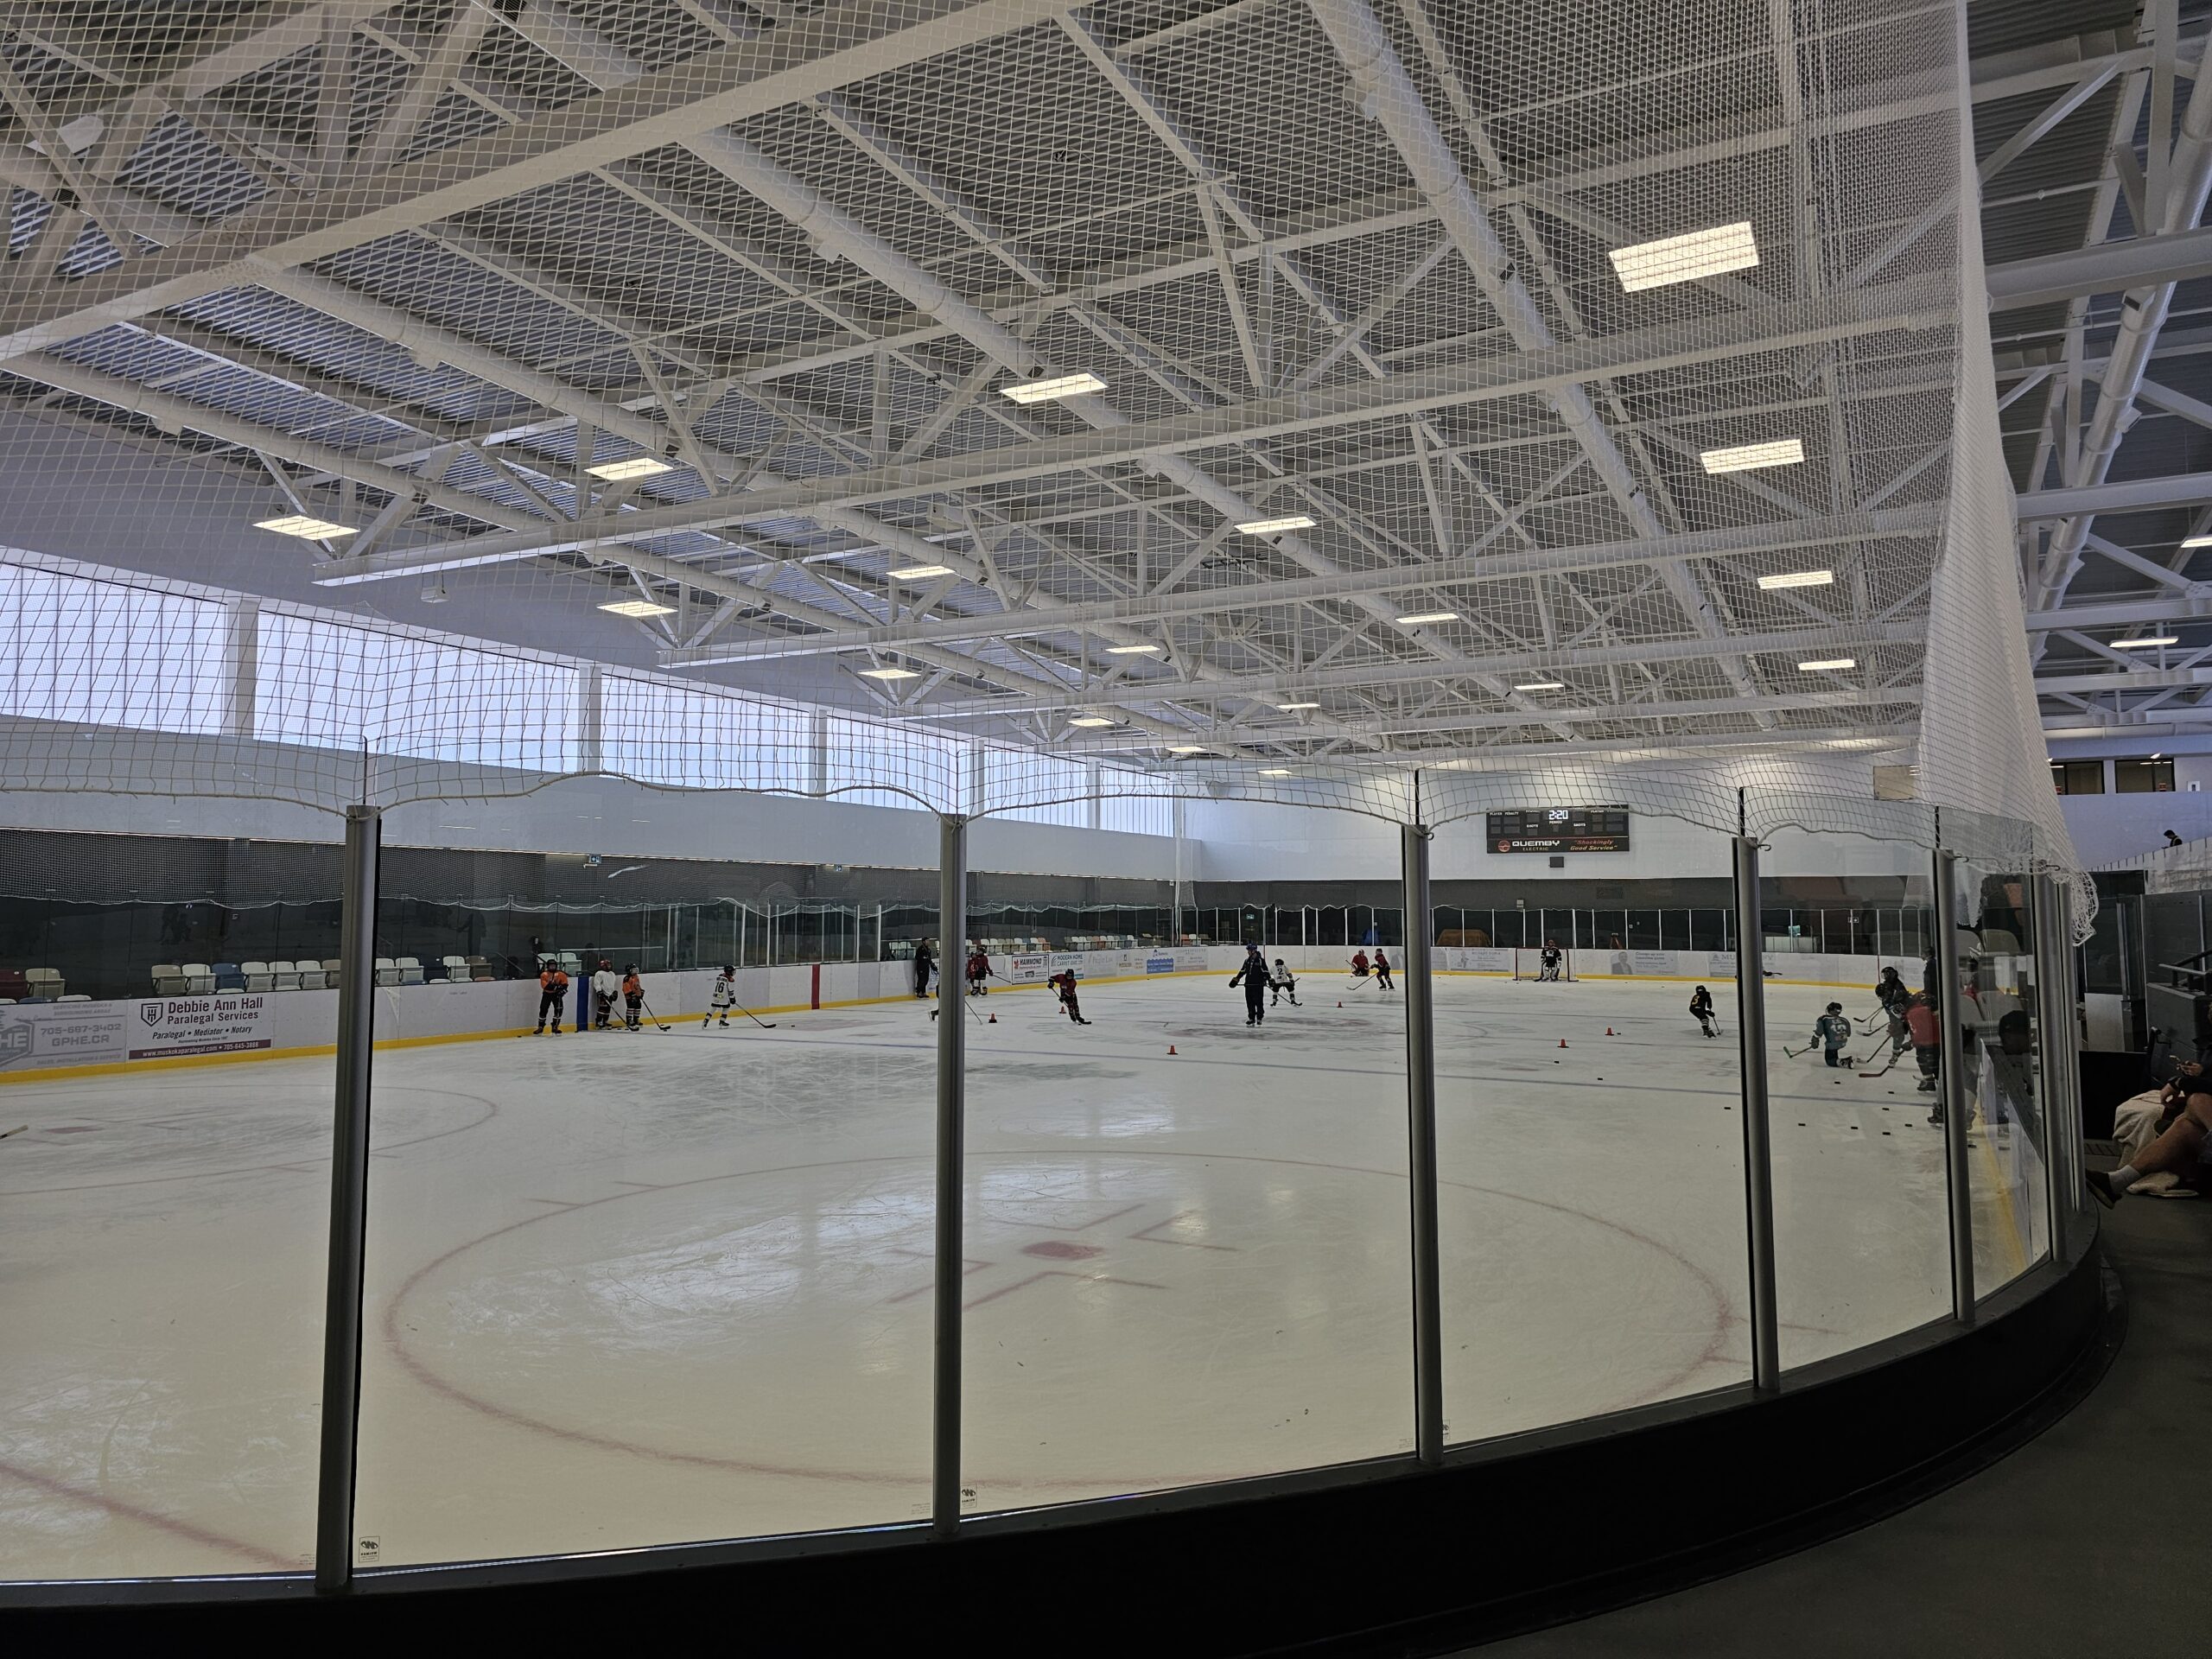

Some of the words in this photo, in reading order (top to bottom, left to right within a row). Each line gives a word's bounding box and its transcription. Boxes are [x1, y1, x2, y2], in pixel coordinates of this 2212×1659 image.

[1548, 810, 1569, 820] 2:20
[715, 981, 725, 993] 16
[168, 1000, 209, 1014] Debbie
[214, 999, 237, 1011] Ann
[242, 997, 264, 1009] Hall
[168, 1013, 214, 1026] Paralegal
[218, 1011, 259, 1021] Services
[152, 1030, 186, 1039] Paralegal
[194, 1027, 224, 1037] Mediator
[231, 1026, 252, 1035] Notary
